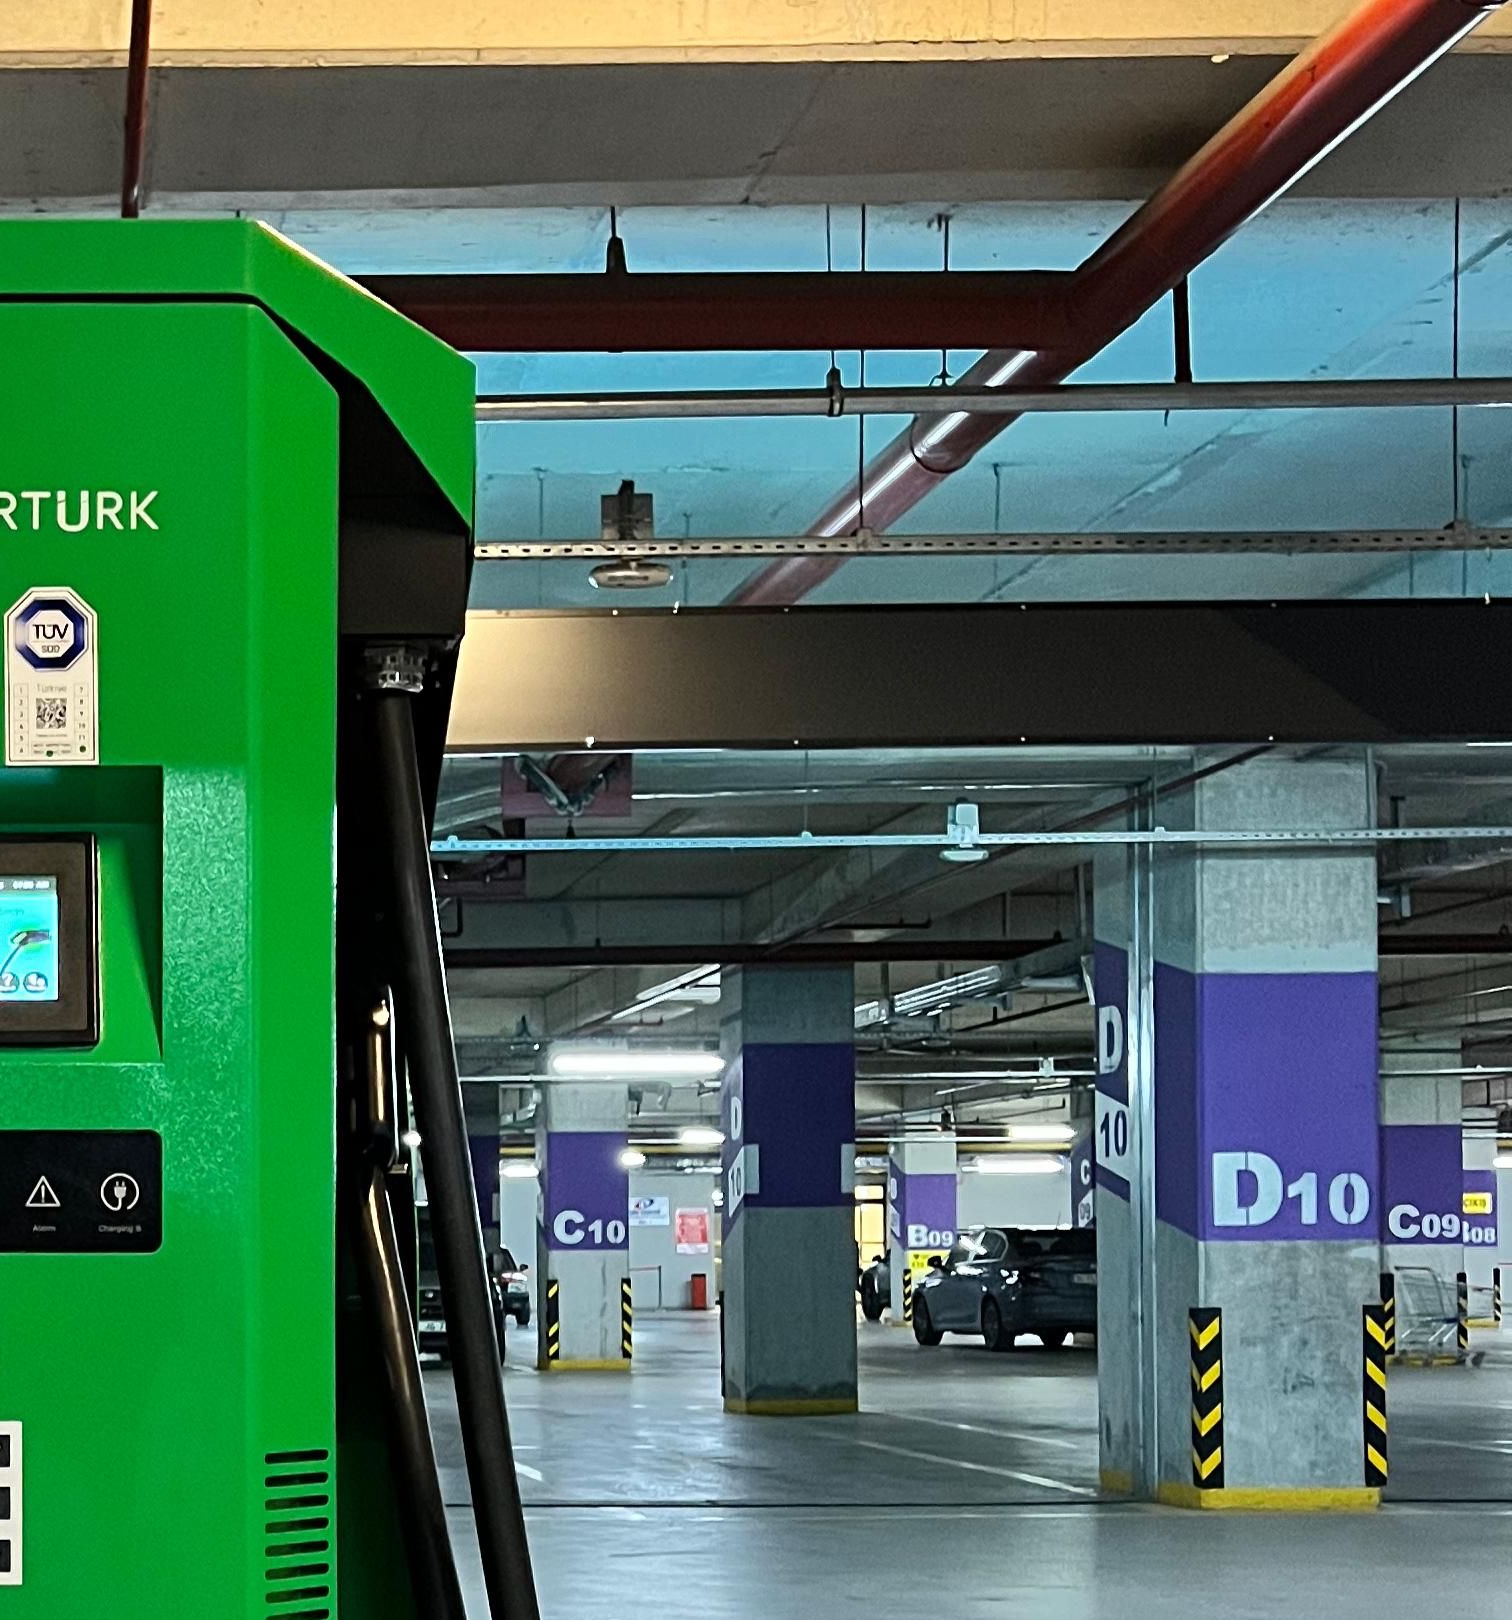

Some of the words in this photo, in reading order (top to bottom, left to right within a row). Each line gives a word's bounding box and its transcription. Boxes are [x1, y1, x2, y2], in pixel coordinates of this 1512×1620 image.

[33, 623, 69, 640] TÜV
[1099, 1004, 1123, 1075] D
[1100, 1110, 1128, 1158] 10
[1212, 1151, 1371, 1227] D10
[553, 1209, 626, 1245] C10
[908, 1223, 954, 1248] B09
[1388, 1203, 1461, 1239] C09
